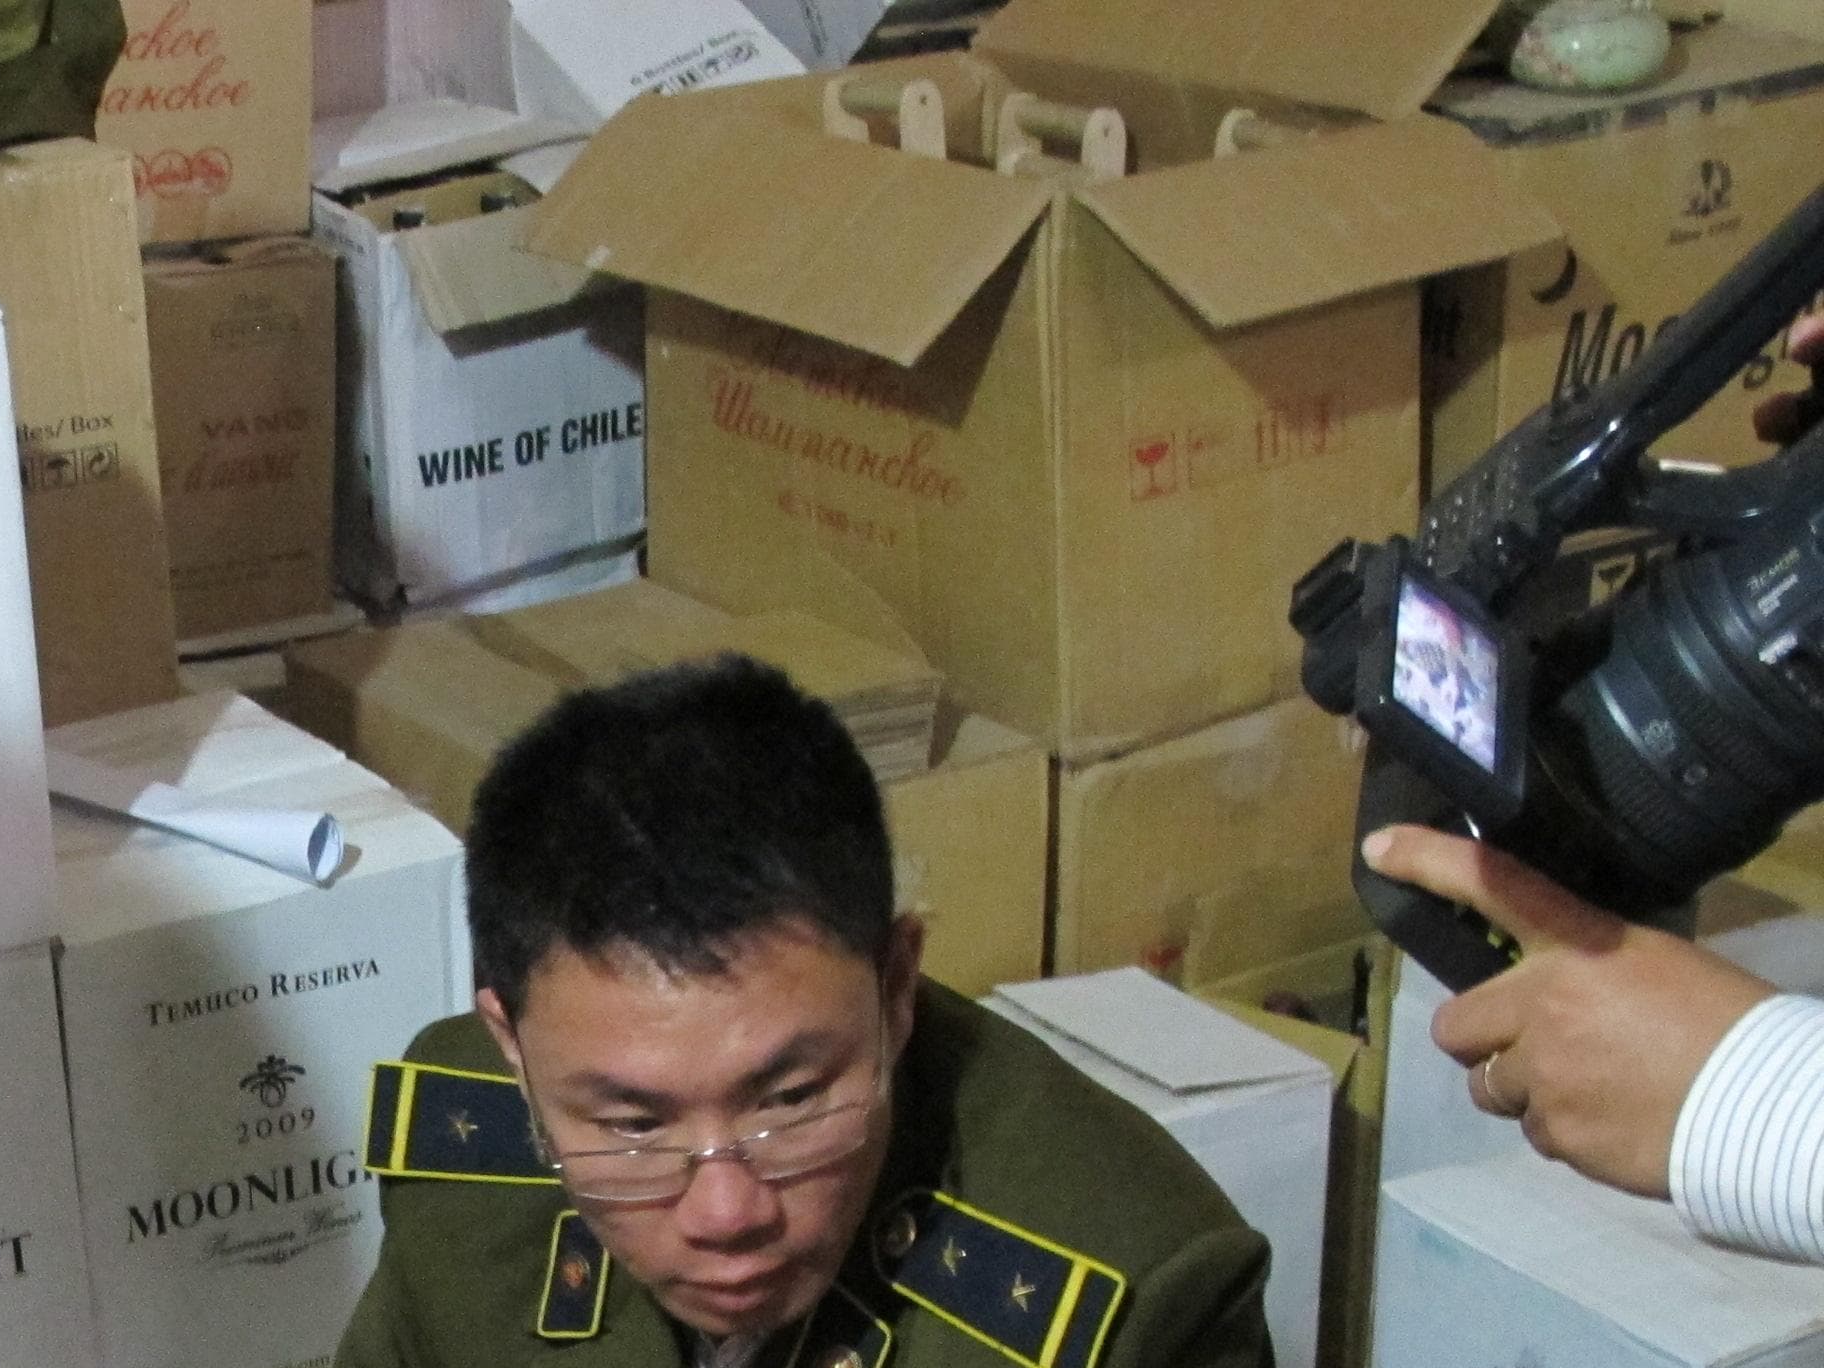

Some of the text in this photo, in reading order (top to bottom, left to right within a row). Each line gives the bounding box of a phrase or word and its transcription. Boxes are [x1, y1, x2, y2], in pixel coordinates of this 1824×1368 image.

[71, 413, 113, 434] Box
[417, 402, 642, 488] WINE OF CHILE
[236, 1106, 316, 1146] 2009
[127, 1149, 373, 1244] MOONLIG
